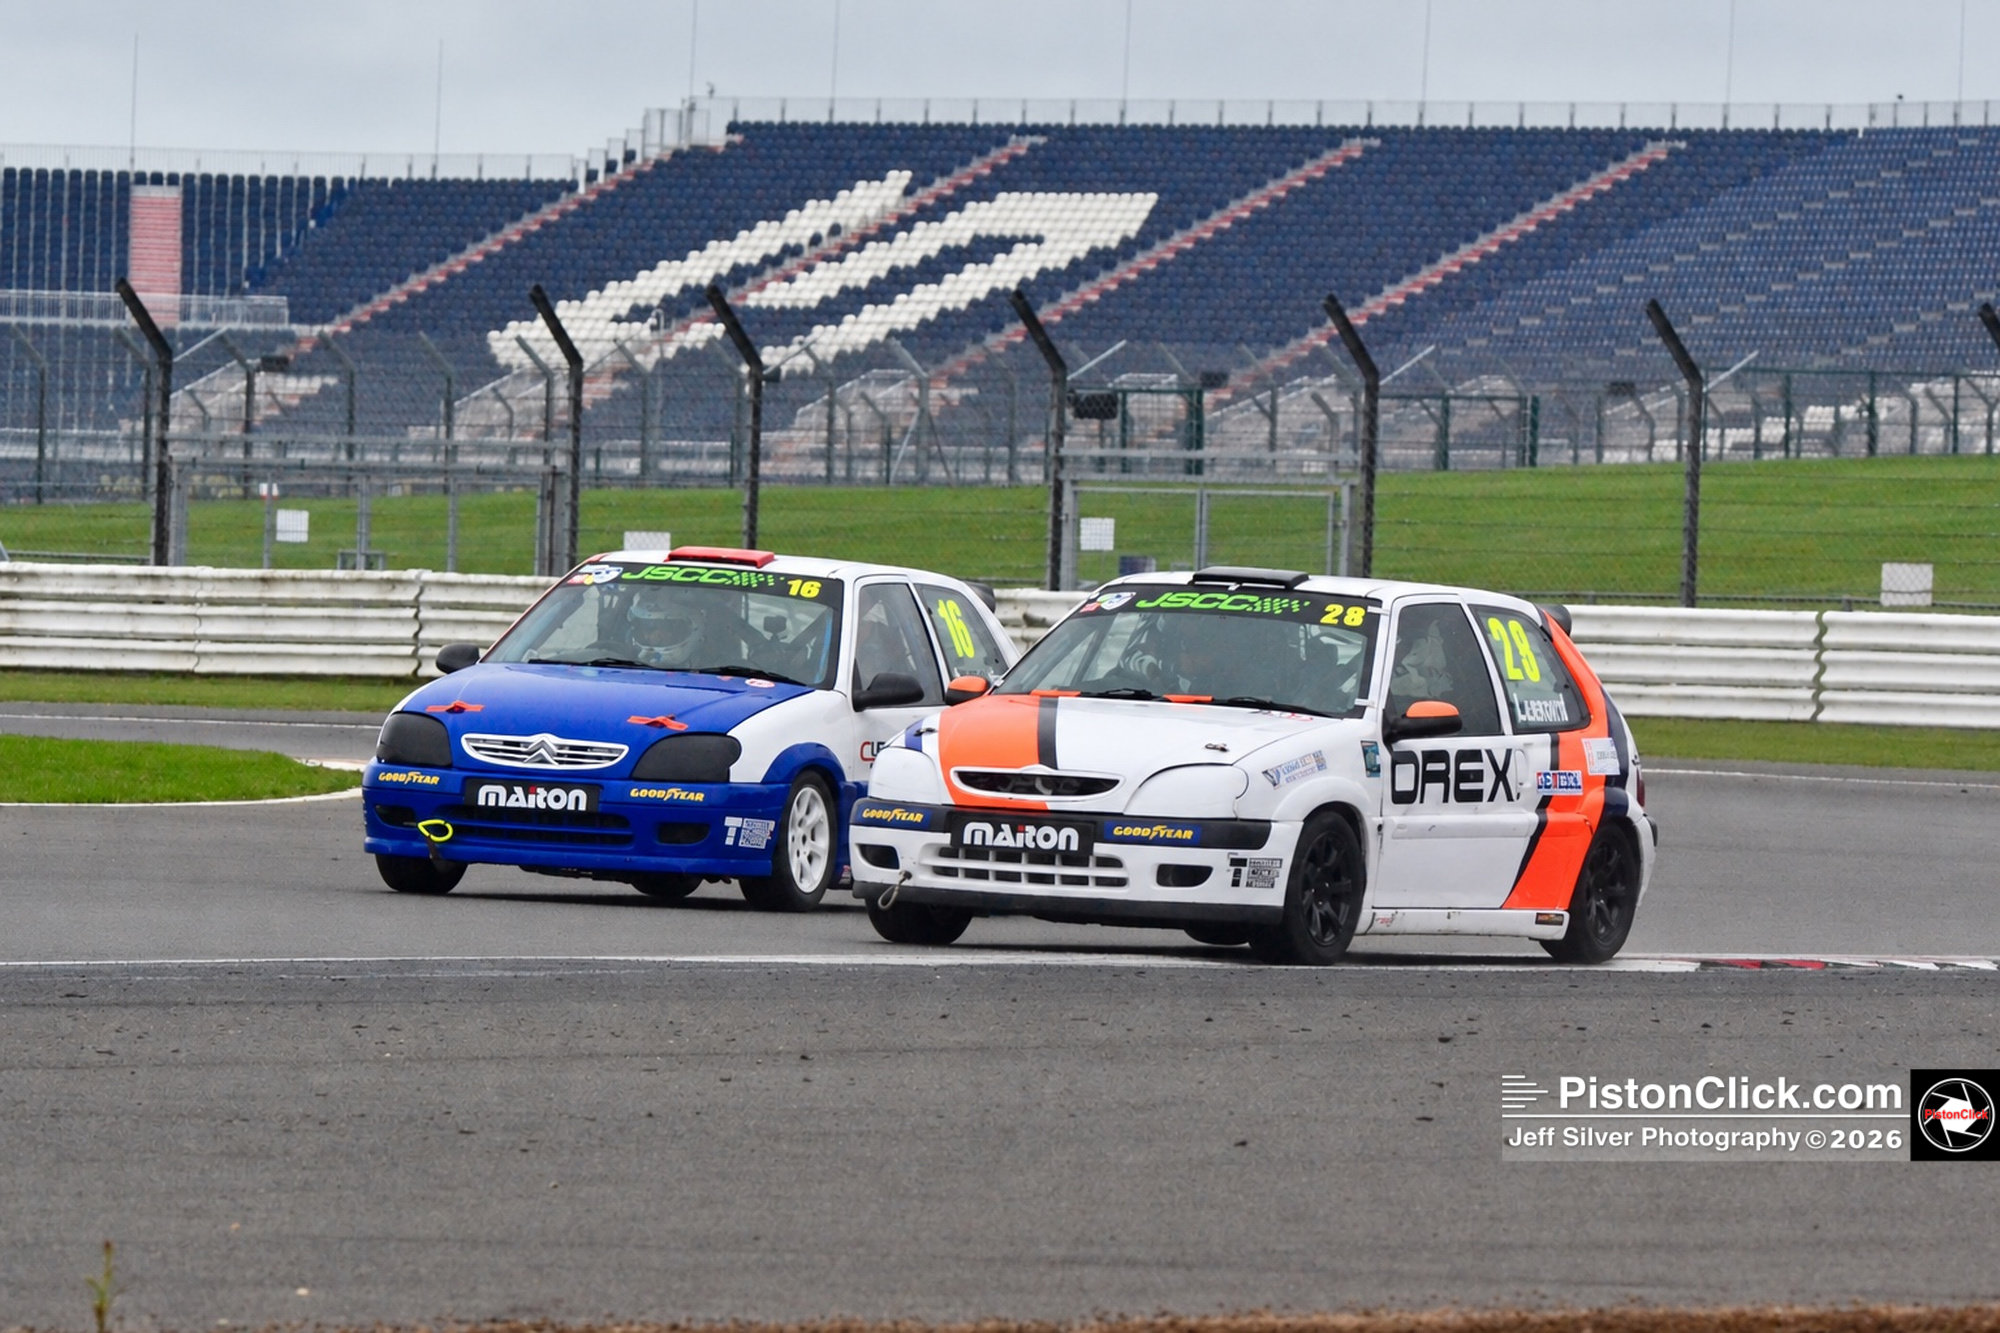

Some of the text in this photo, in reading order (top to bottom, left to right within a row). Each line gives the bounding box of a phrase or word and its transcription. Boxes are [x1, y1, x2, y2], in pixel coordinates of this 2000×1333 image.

[622, 565, 731, 585] JSCC
[788, 578, 823, 599] 16
[1135, 592, 1258, 612] JSCC
[1320, 603, 1367, 627] 28
[937, 599, 975, 659] 16
[1487, 617, 1541, 683] 28
[630, 788, 705, 802] GOODYEAR
[1113, 825, 1194, 840] GOODYEAR
